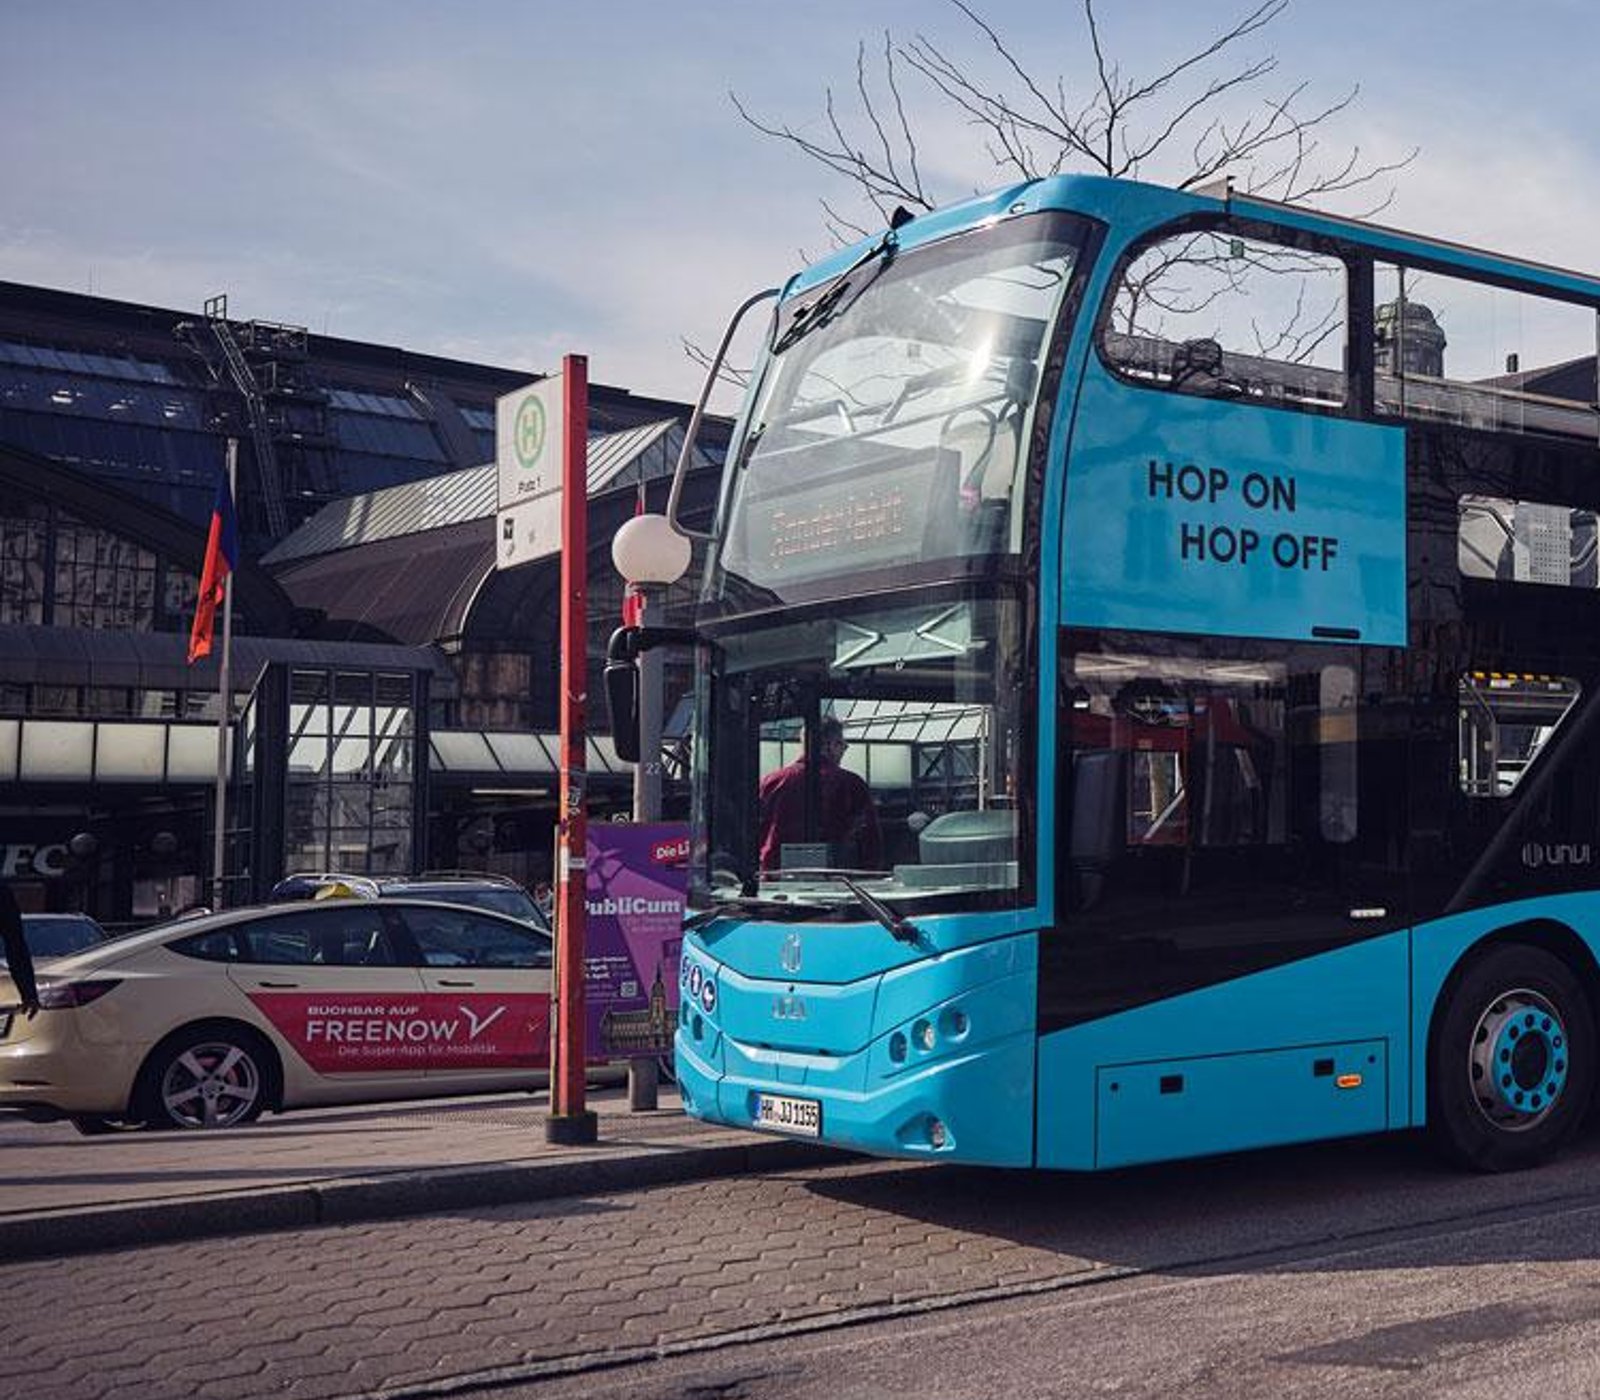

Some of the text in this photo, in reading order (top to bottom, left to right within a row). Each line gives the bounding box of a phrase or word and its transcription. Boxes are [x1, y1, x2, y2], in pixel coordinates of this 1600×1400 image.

[1149, 460, 1296, 512] HOP ON
[1181, 523, 1339, 571] HOP OFF
[0, 844, 69, 877] FC
[656, 845, 676, 860] Die
[307, 1005, 419, 1016] BUCHBAR AUF
[305, 1020, 459, 1043] FREENOW
[338, 1045, 358, 1055] Die
